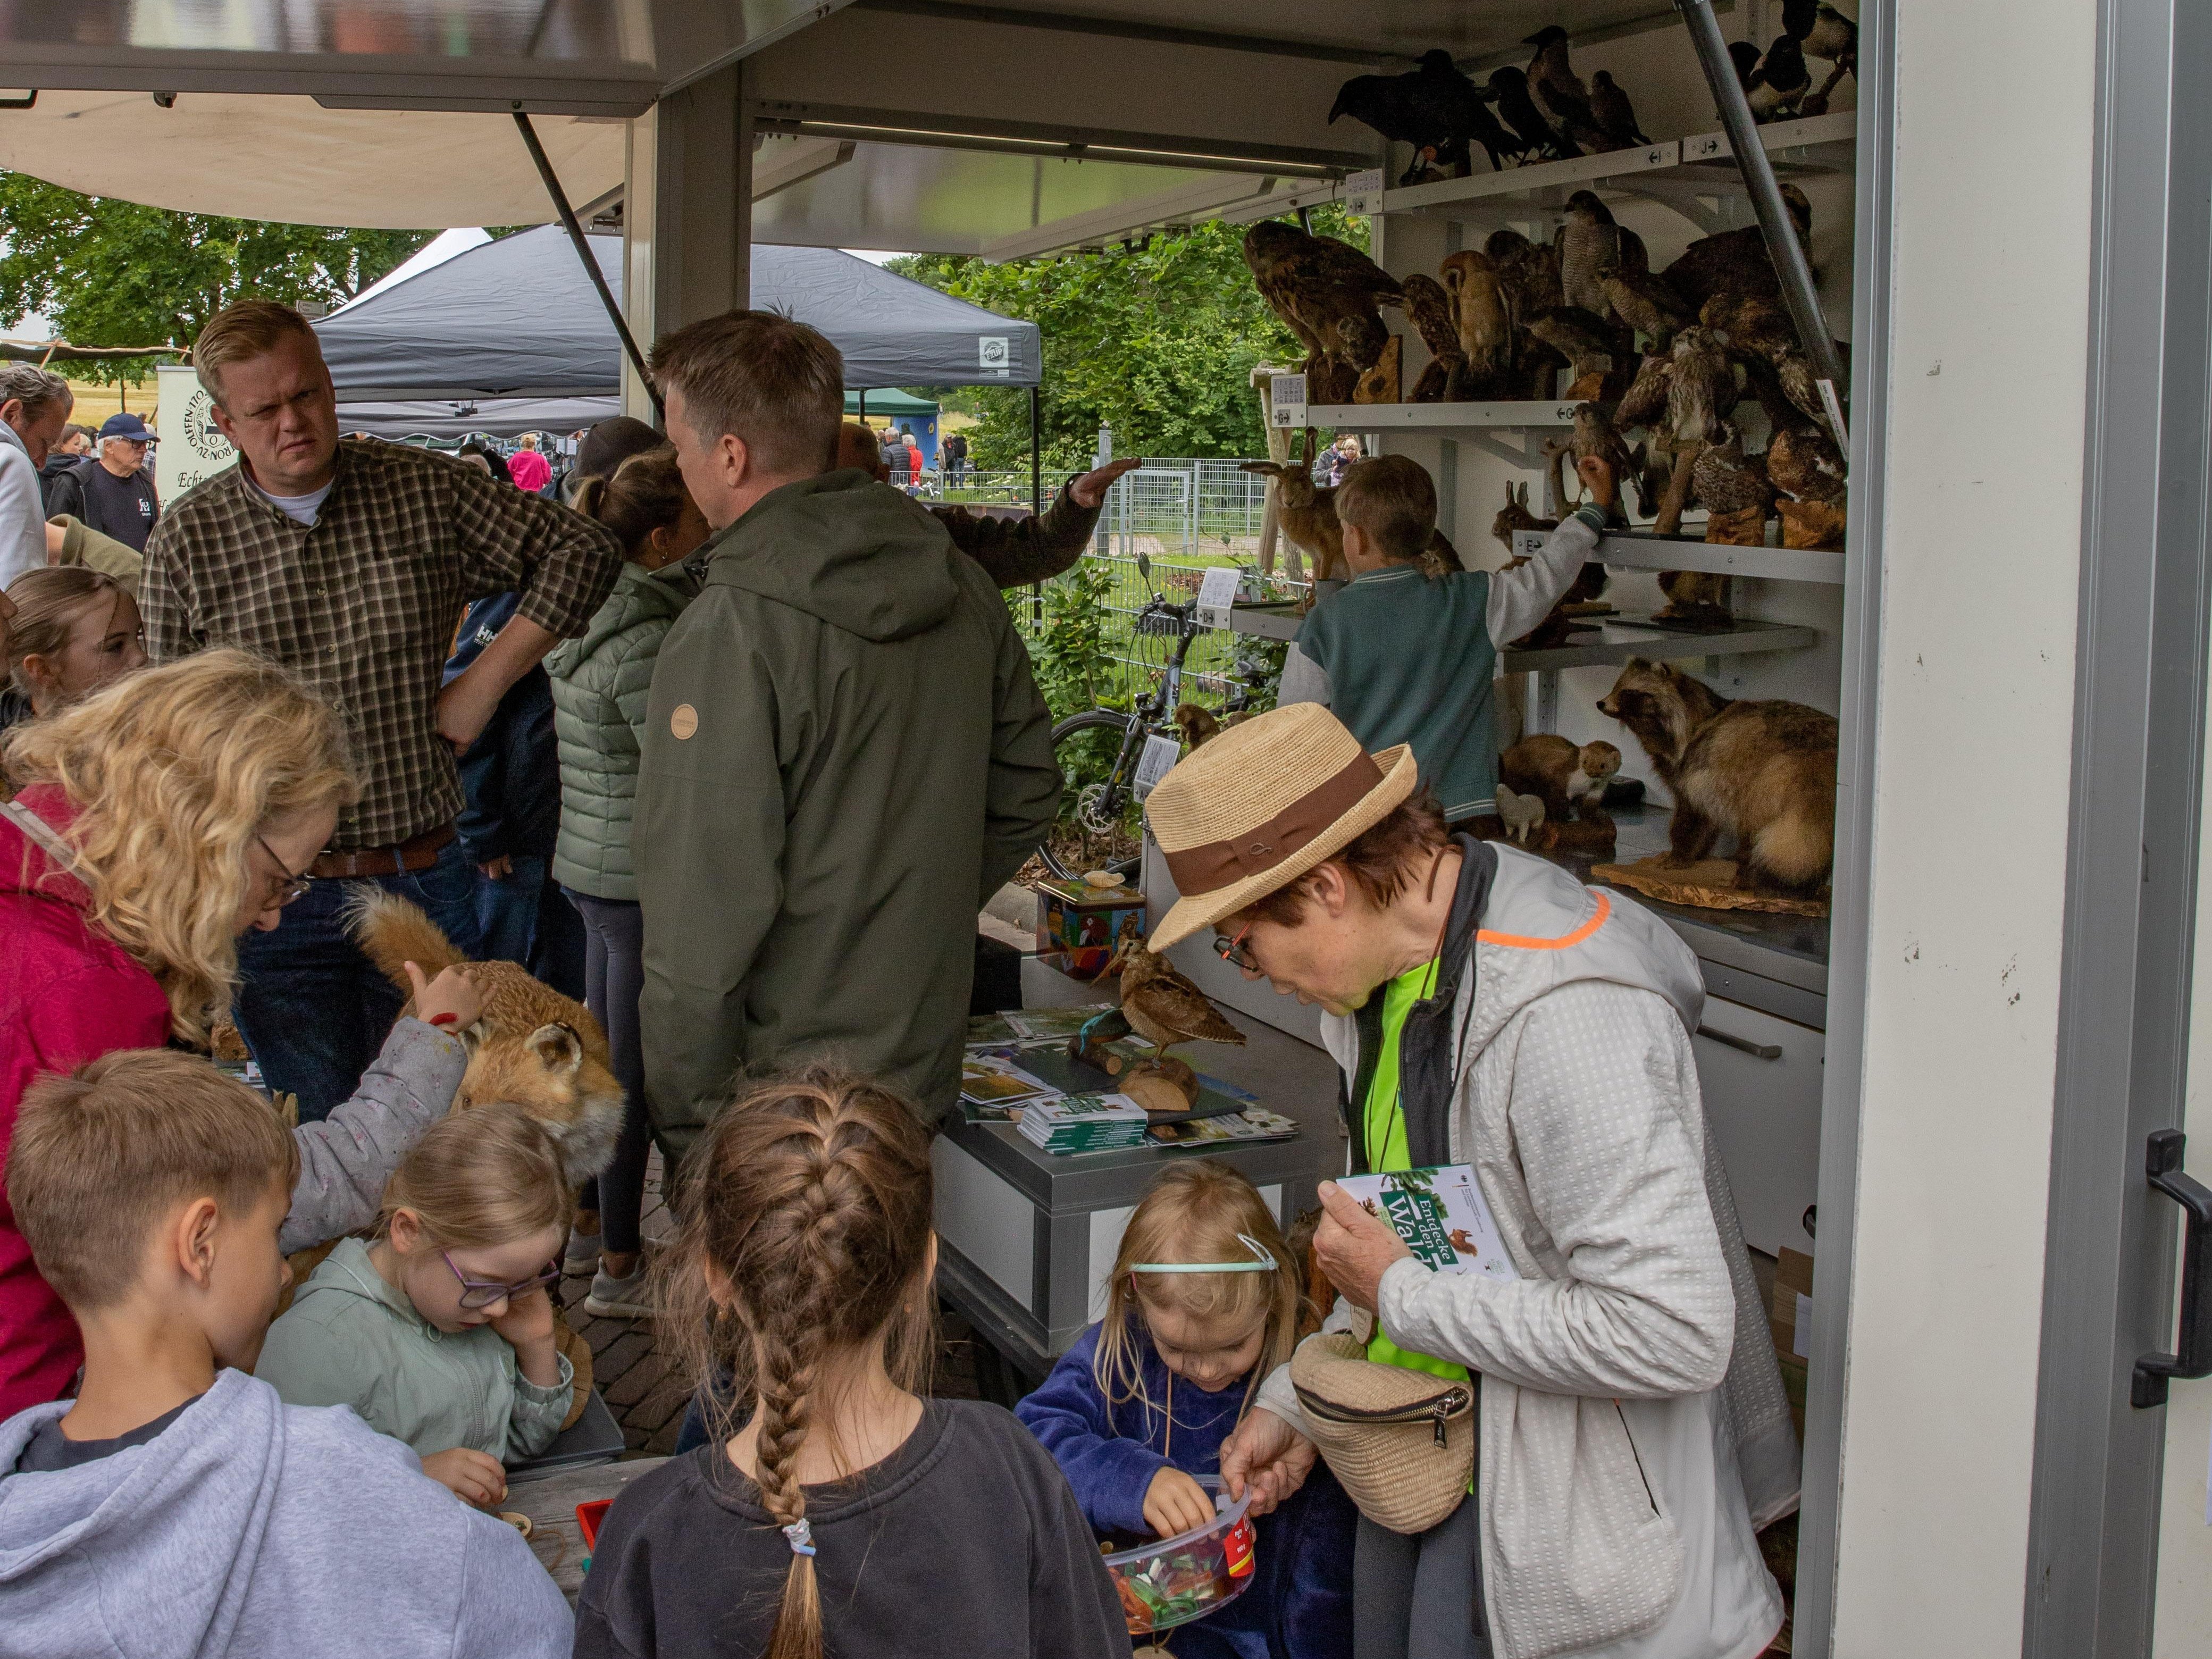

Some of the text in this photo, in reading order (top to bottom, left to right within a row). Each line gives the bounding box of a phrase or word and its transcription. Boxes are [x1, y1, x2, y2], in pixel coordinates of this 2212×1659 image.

[1702, 142, 1707, 154] J
[1278, 413, 1284, 423] G
[184, 409, 197, 448] OLFFEN
[178, 470, 207, 488] Echt
[1527, 540, 1532, 552] E
[1203, 612, 1208, 623] D
[477, 625, 499, 643] HH
[1419, 1200, 1450, 1259] Entdecke
[1419, 1225, 1434, 1249] den
